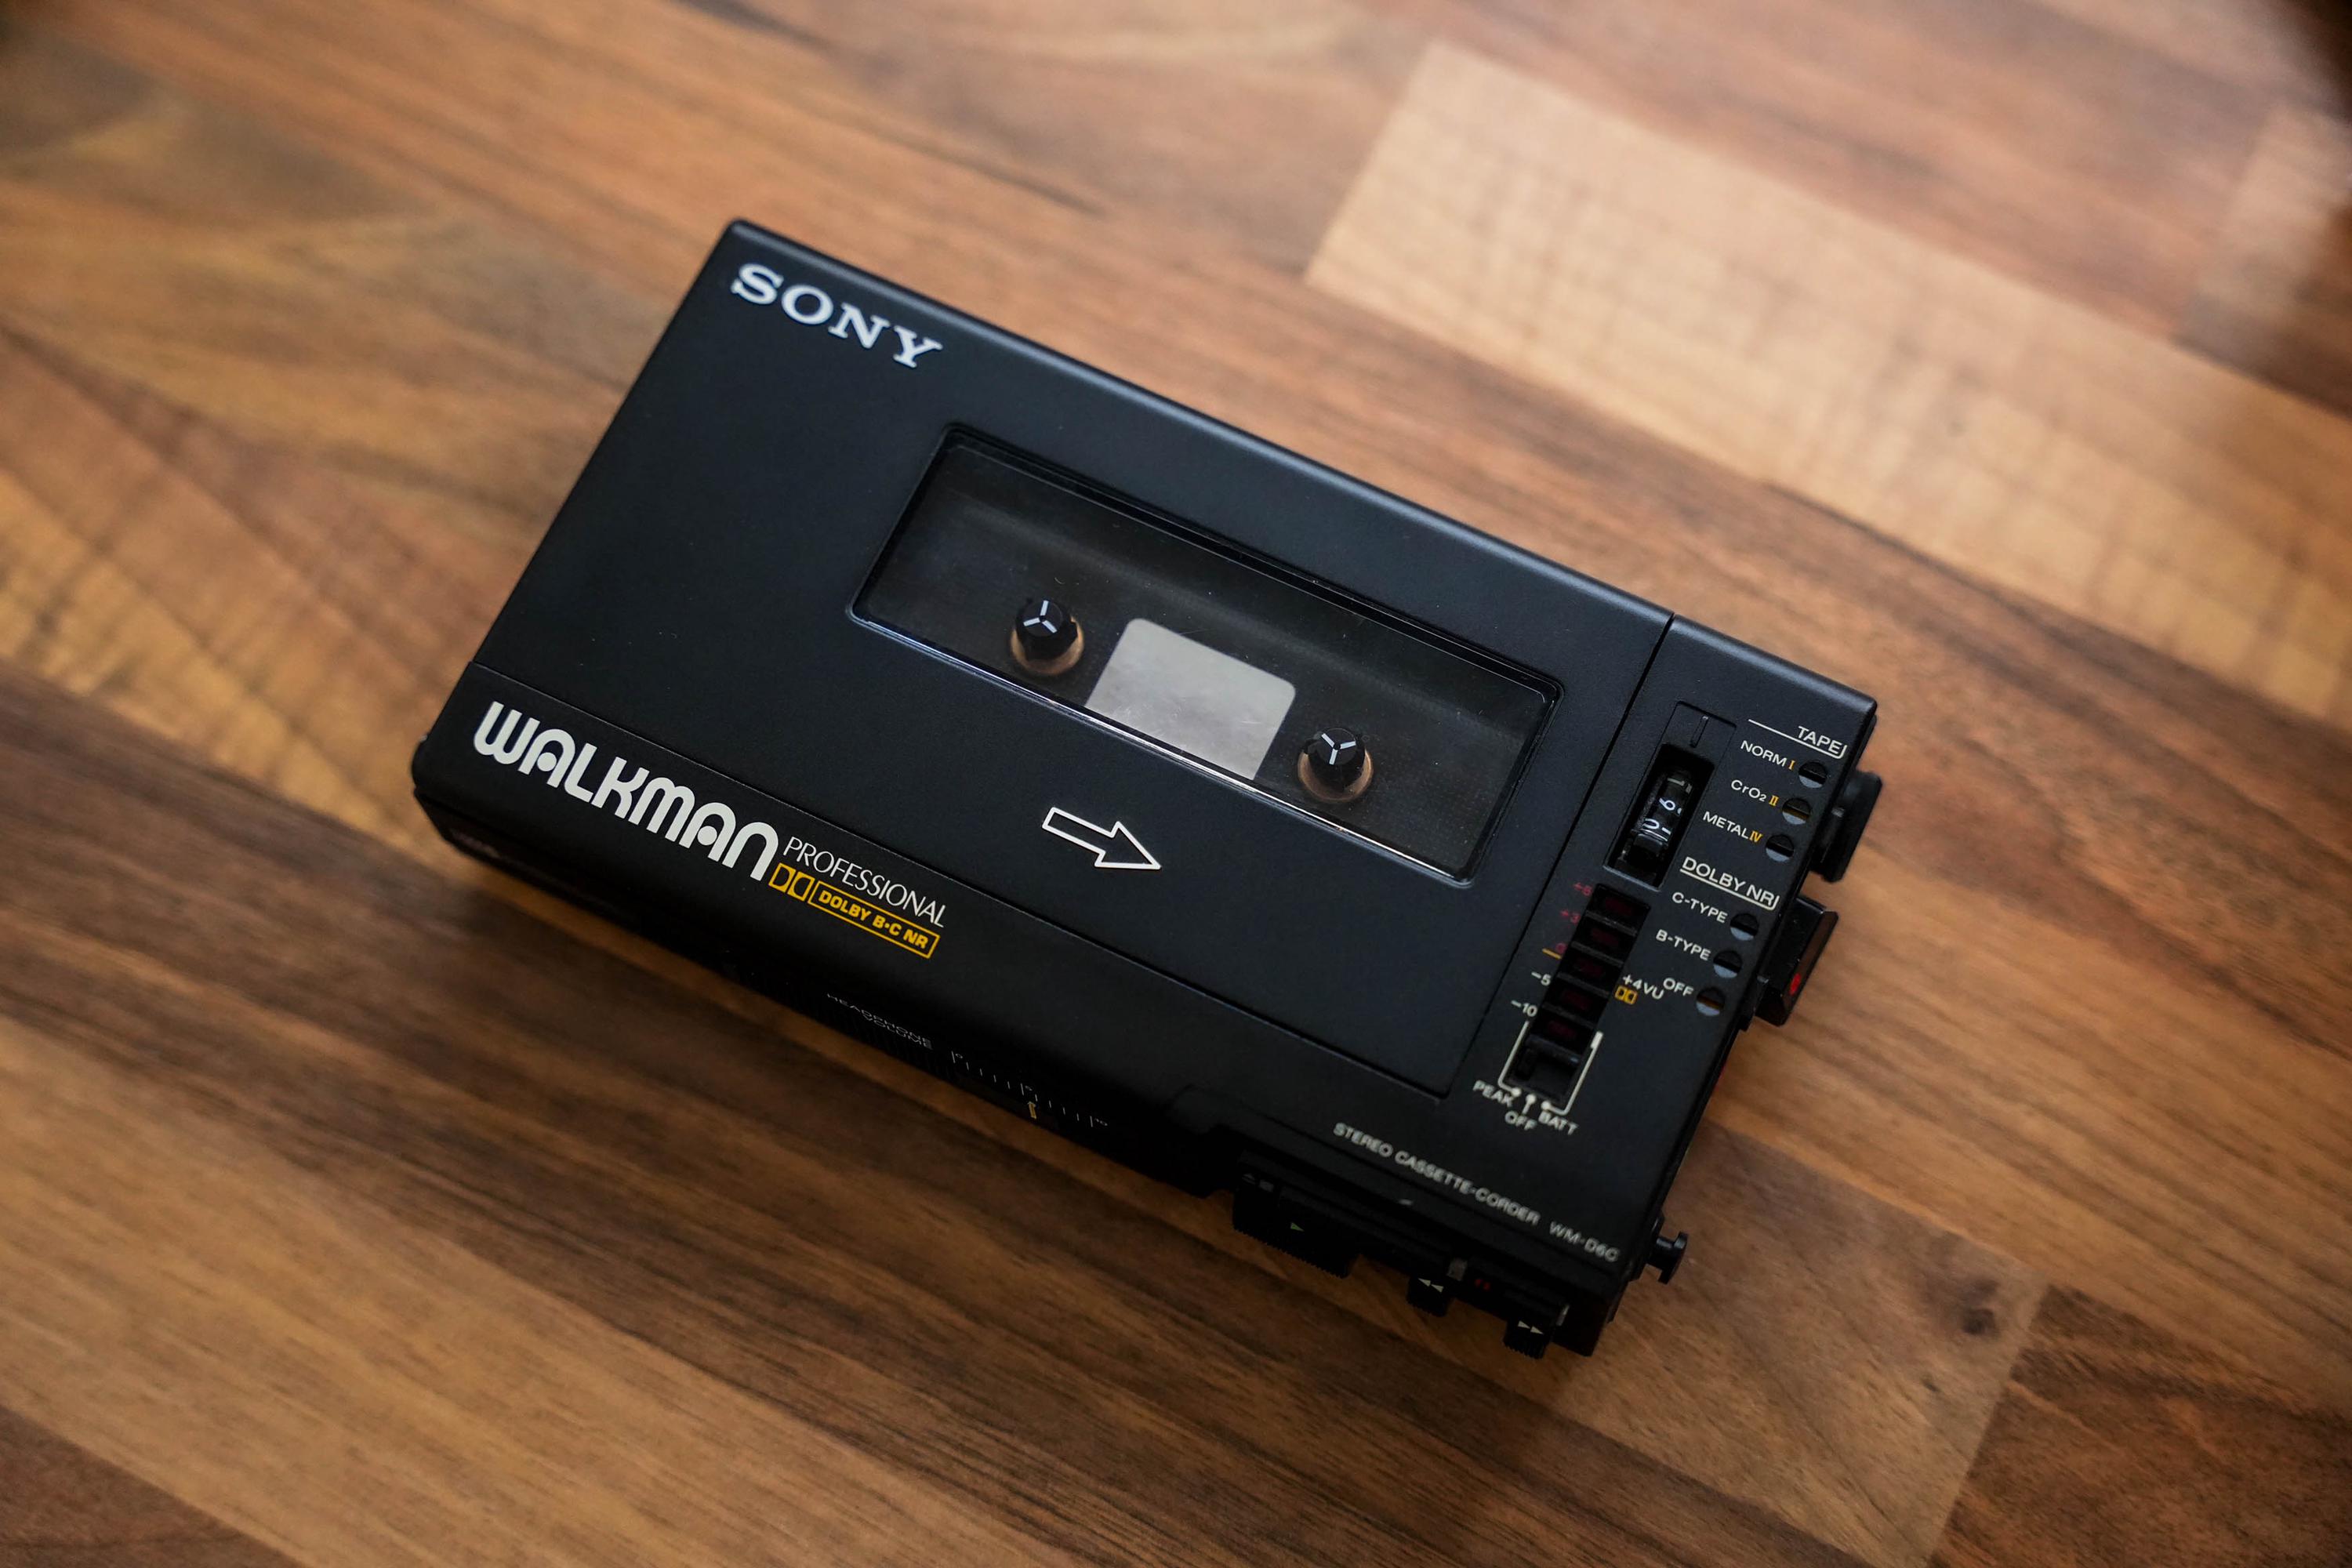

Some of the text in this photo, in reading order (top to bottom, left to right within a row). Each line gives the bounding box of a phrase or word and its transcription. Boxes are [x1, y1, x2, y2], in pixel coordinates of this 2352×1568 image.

[731, 263, 942, 368] SONY
[1740, 739, 1788, 768] NORM
[1798, 725, 1843, 755] TAPE
[474, 700, 779, 881] WALKMAN
[1702, 811, 1749, 840] METAL
[783, 836, 946, 928] PROFESSIONAL
[1682, 856, 1774, 906] DOLBY NR
[818, 889, 871, 921] DOLBY
[903, 928, 928, 949] NR
[1671, 891, 1728, 924] C-TYPE
[1655, 928, 1711, 961] B-TYPE
[1531, 971, 1552, 986] -5
[1663, 977, 1694, 996] OFF
[1511, 1000, 1538, 1017] -10
[1472, 1080, 1514, 1108] PEAK
[1504, 1109, 1538, 1131] OFF
[1537, 1109, 1579, 1135] BATT
[1333, 1122, 1394, 1158] STEREO
[1395, 1149, 1541, 1226] CASSETTE-CORDER
